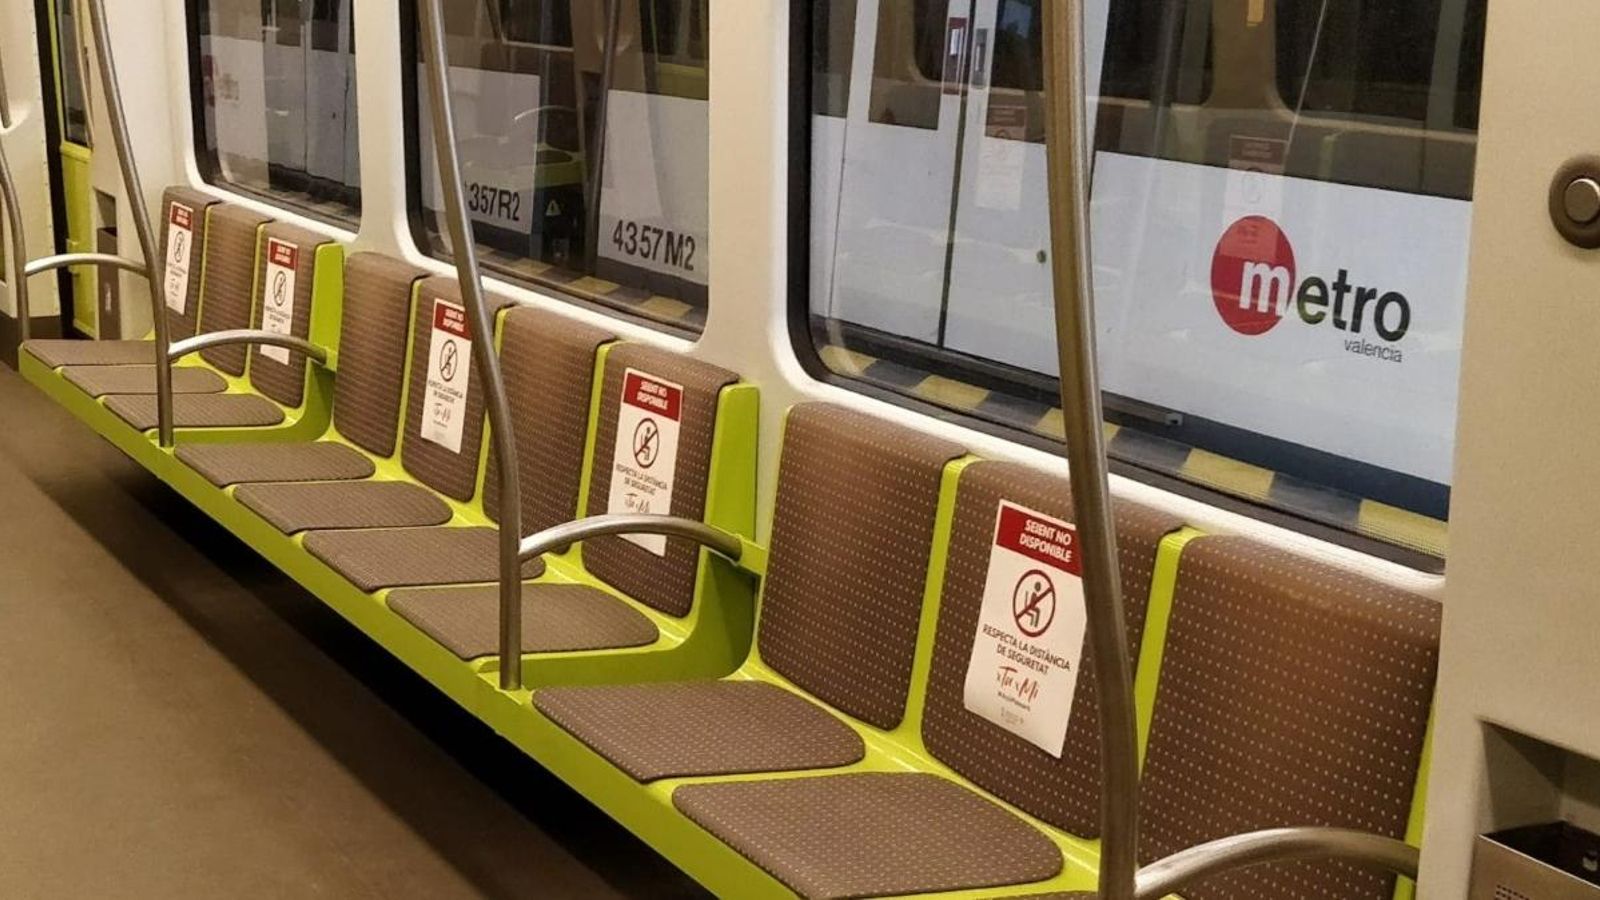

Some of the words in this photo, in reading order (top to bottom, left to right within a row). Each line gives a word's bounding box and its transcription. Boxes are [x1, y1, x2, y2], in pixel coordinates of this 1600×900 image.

[464, 182, 520, 221] 357R2
[613, 220, 696, 271] 4357M2
[1239, 260, 1411, 342] metro
[1344, 338, 1403, 363] valencia
[1024, 519, 1056, 540] SEIENT
[1055, 530, 1072, 546] NO
[1019, 533, 1072, 563] DISPONIBLE
[982, 624, 1017, 647] RESPECTA
[1018, 641, 1029, 653] LA
[996, 644, 1006, 656] DE
[1007, 648, 1050, 675] SEGURETAT
